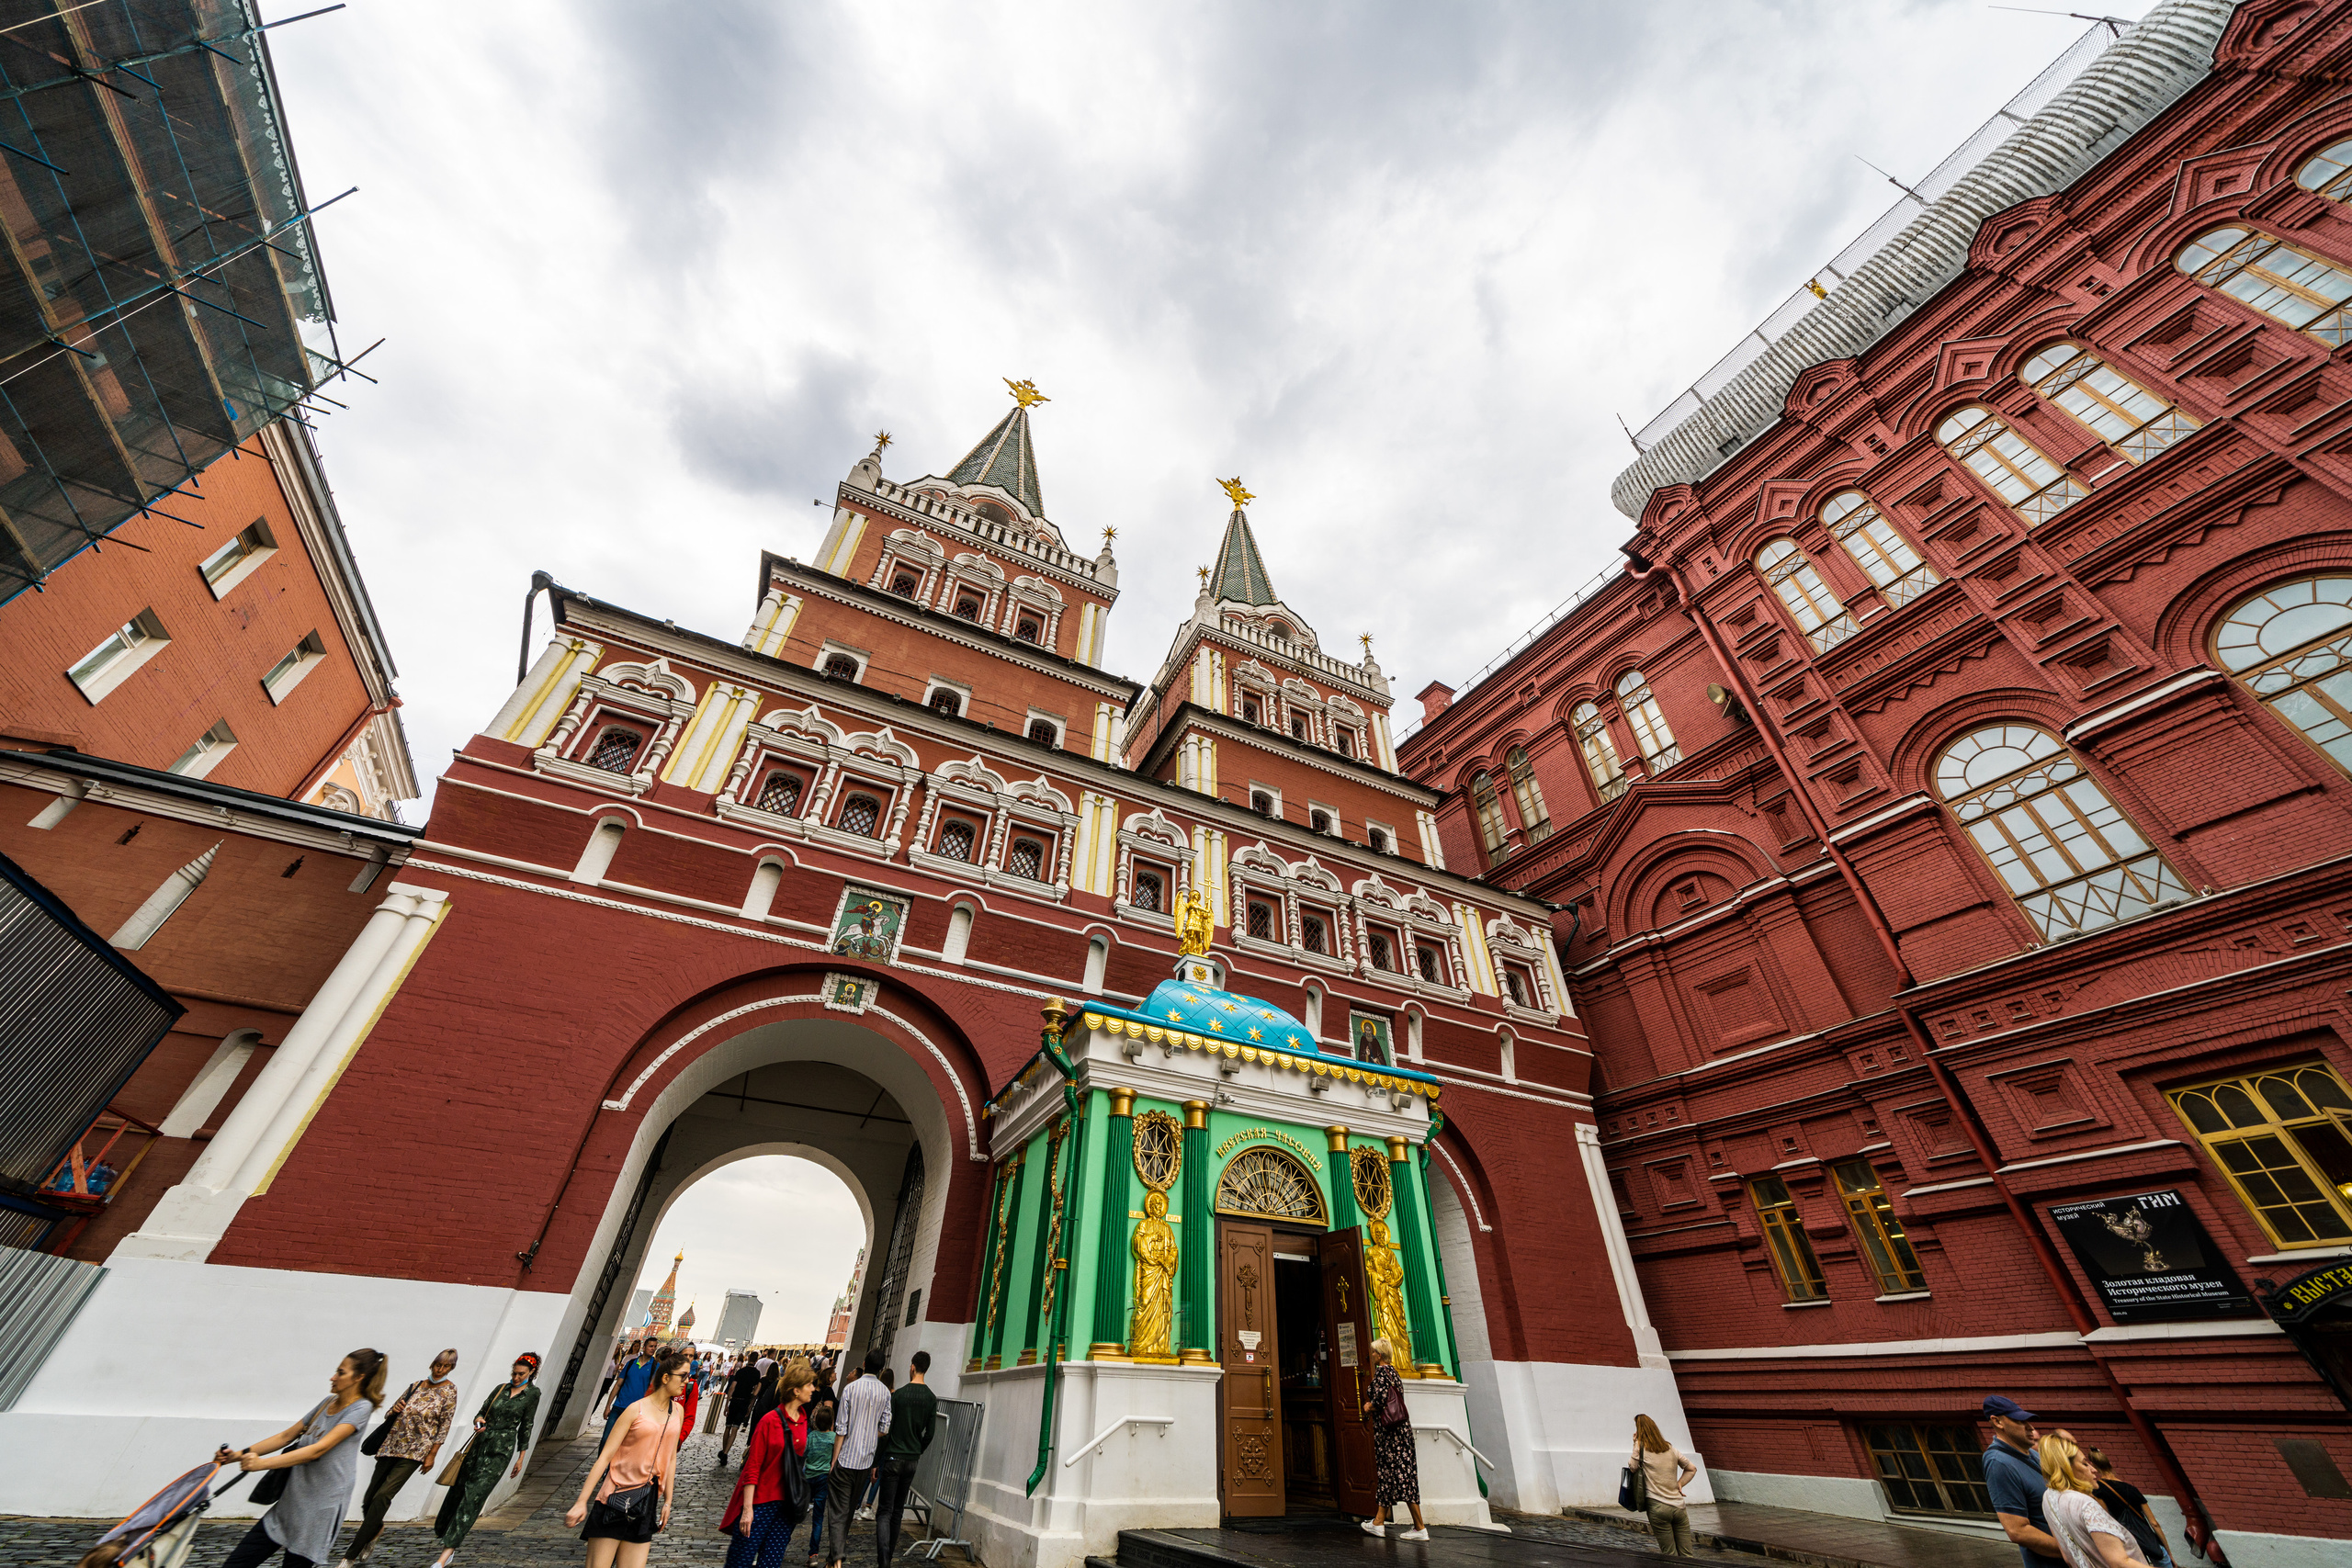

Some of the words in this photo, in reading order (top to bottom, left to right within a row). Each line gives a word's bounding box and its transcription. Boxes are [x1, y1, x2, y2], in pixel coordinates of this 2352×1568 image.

[1216, 1127, 1268, 1158] ИВЕРСКАЯ
[1275, 1129, 1323, 1172] ЧАСОВНЯ
[2052, 1201, 2106, 1214] ИСТОРИЧЕСКИЙ
[2137, 1192, 2182, 1210] ГИМ
[2056, 1213, 2080, 1222] МУЗЕЙ
[2101, 1278, 2145, 1289] Золотая
[2144, 1274, 2197, 1285] кладовая
[2107, 1282, 2188, 1296] Исторического
[2188, 1280, 2224, 1292] музея
[2289, 1266, 2352, 1304] ВЫСТА
[2171, 1292, 2202, 1300] Historical
